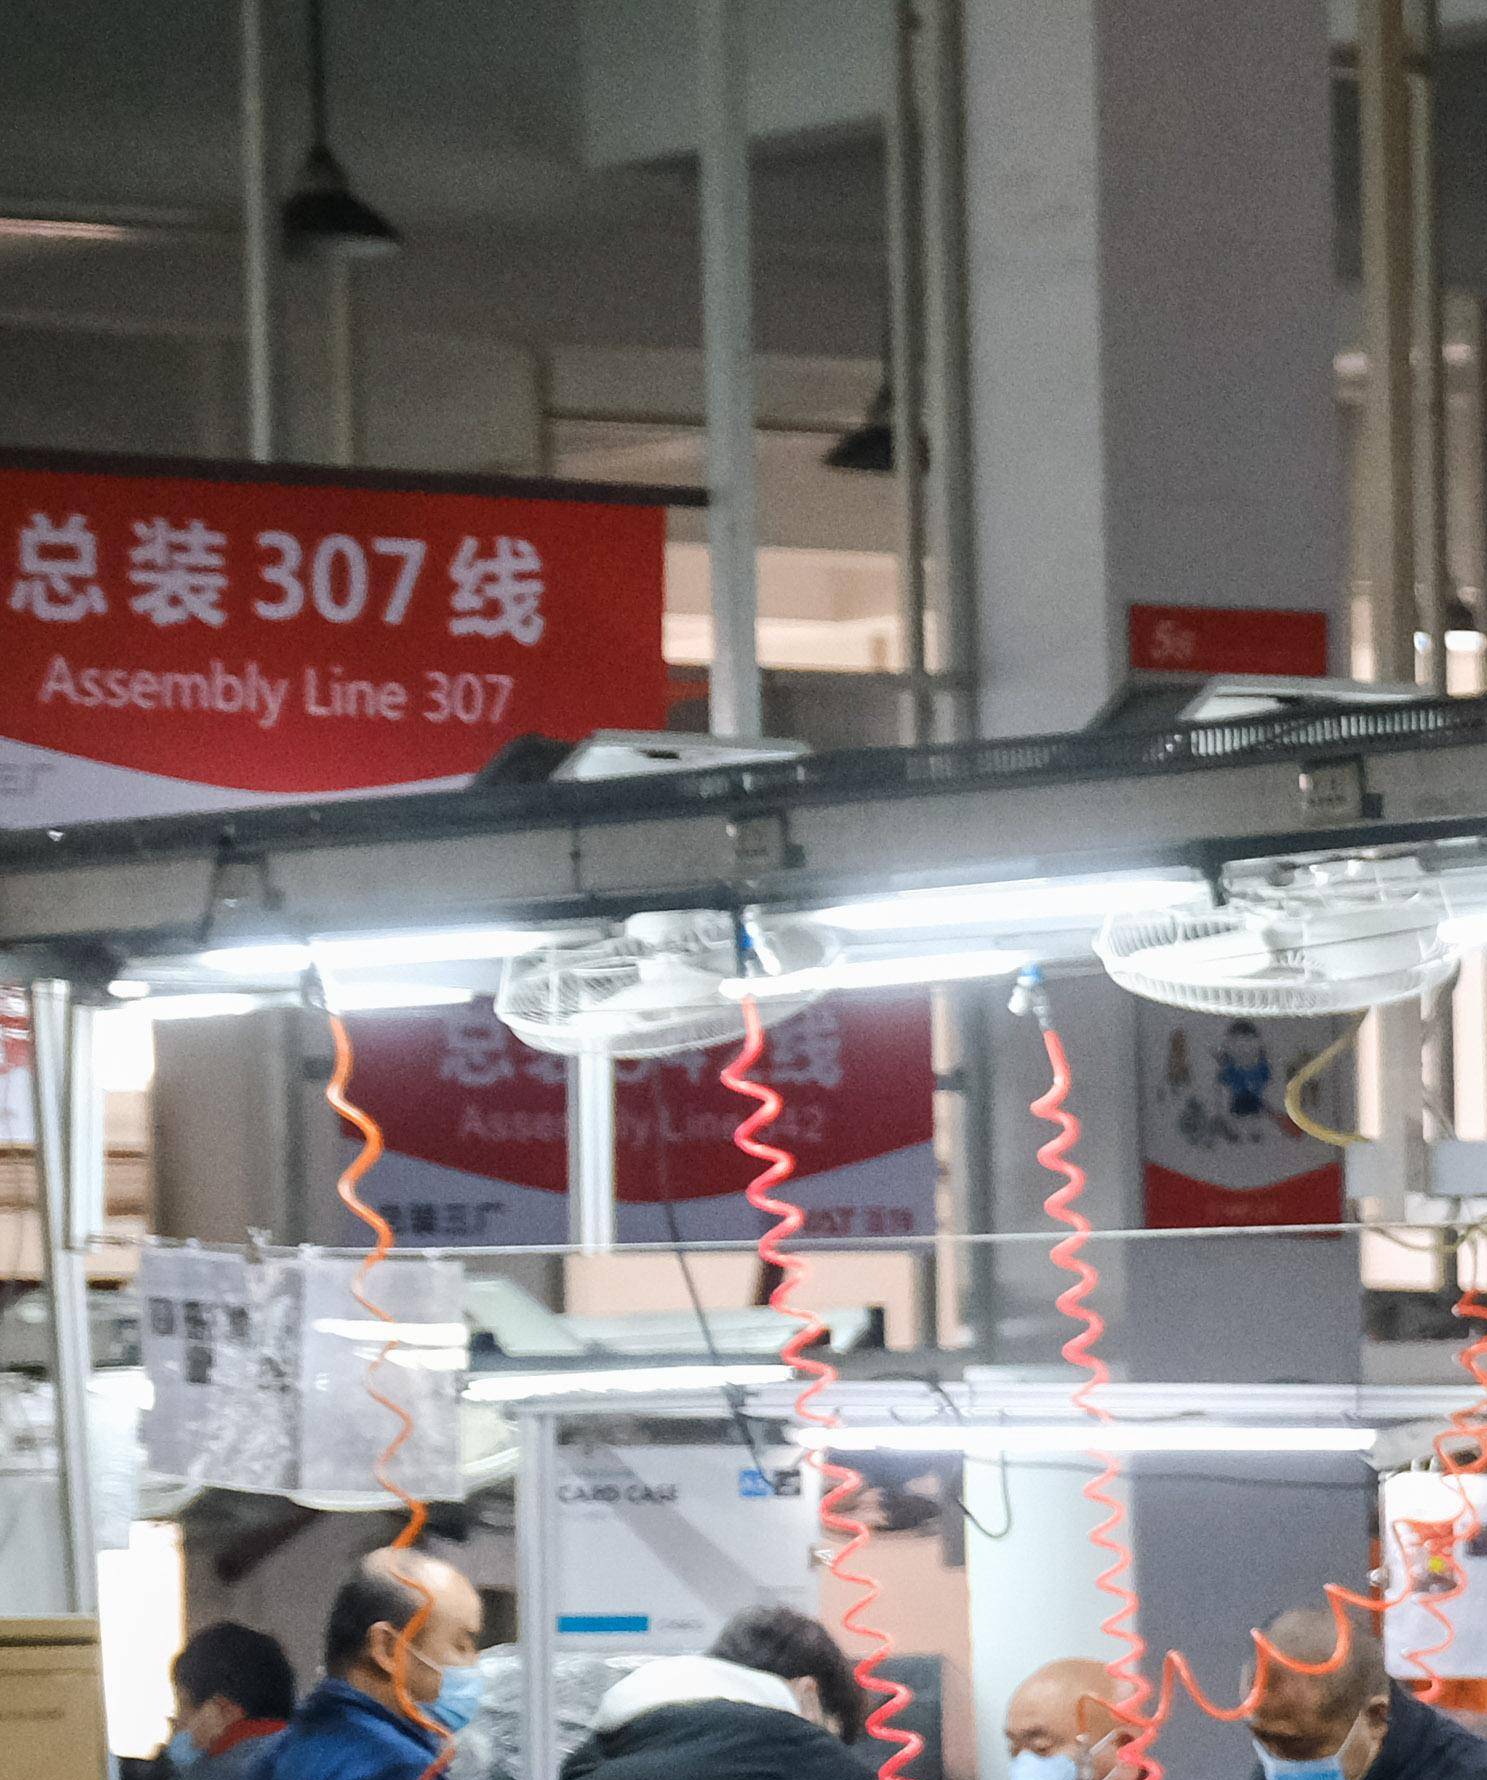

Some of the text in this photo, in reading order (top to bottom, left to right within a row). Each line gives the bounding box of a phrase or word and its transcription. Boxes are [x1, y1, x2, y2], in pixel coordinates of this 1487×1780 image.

[39, 655, 515, 729] Assembly Line 307
